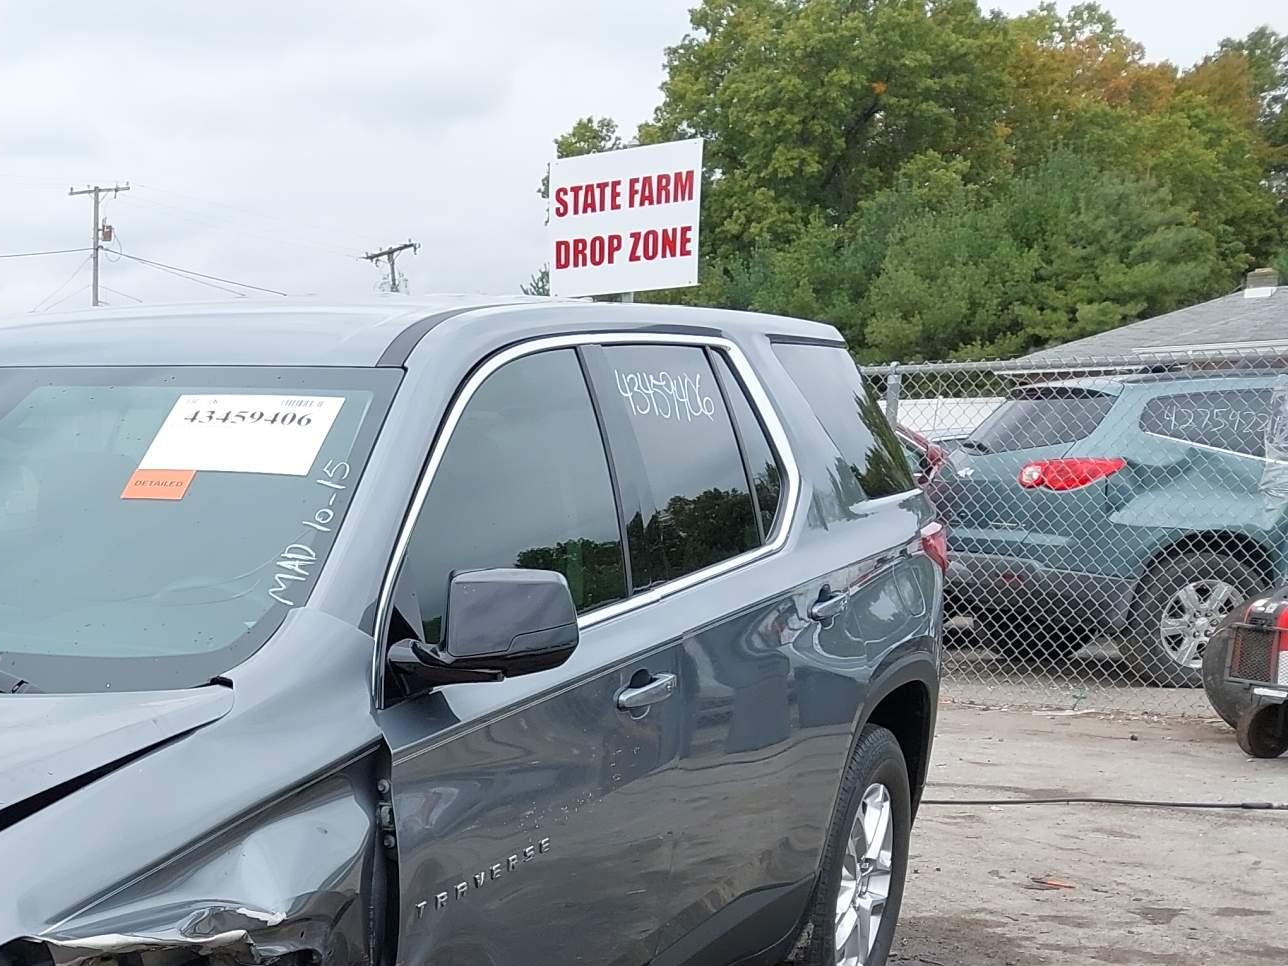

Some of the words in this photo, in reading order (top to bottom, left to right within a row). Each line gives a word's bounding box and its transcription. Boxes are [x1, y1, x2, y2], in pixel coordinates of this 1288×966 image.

[555, 180, 622, 218] STATE
[628, 170, 695, 208] FARM
[555, 235, 622, 270] DROP
[628, 226, 692, 263] ZONE
[183, 410, 313, 426] 43459406
[614, 369, 715, 422] 43459406
[134, 480, 184, 488] DETAILED
[268, 543, 318, 606] MAD
[302, 459, 350, 532] 10-15
[415, 837, 551, 920] TRAVERSE
